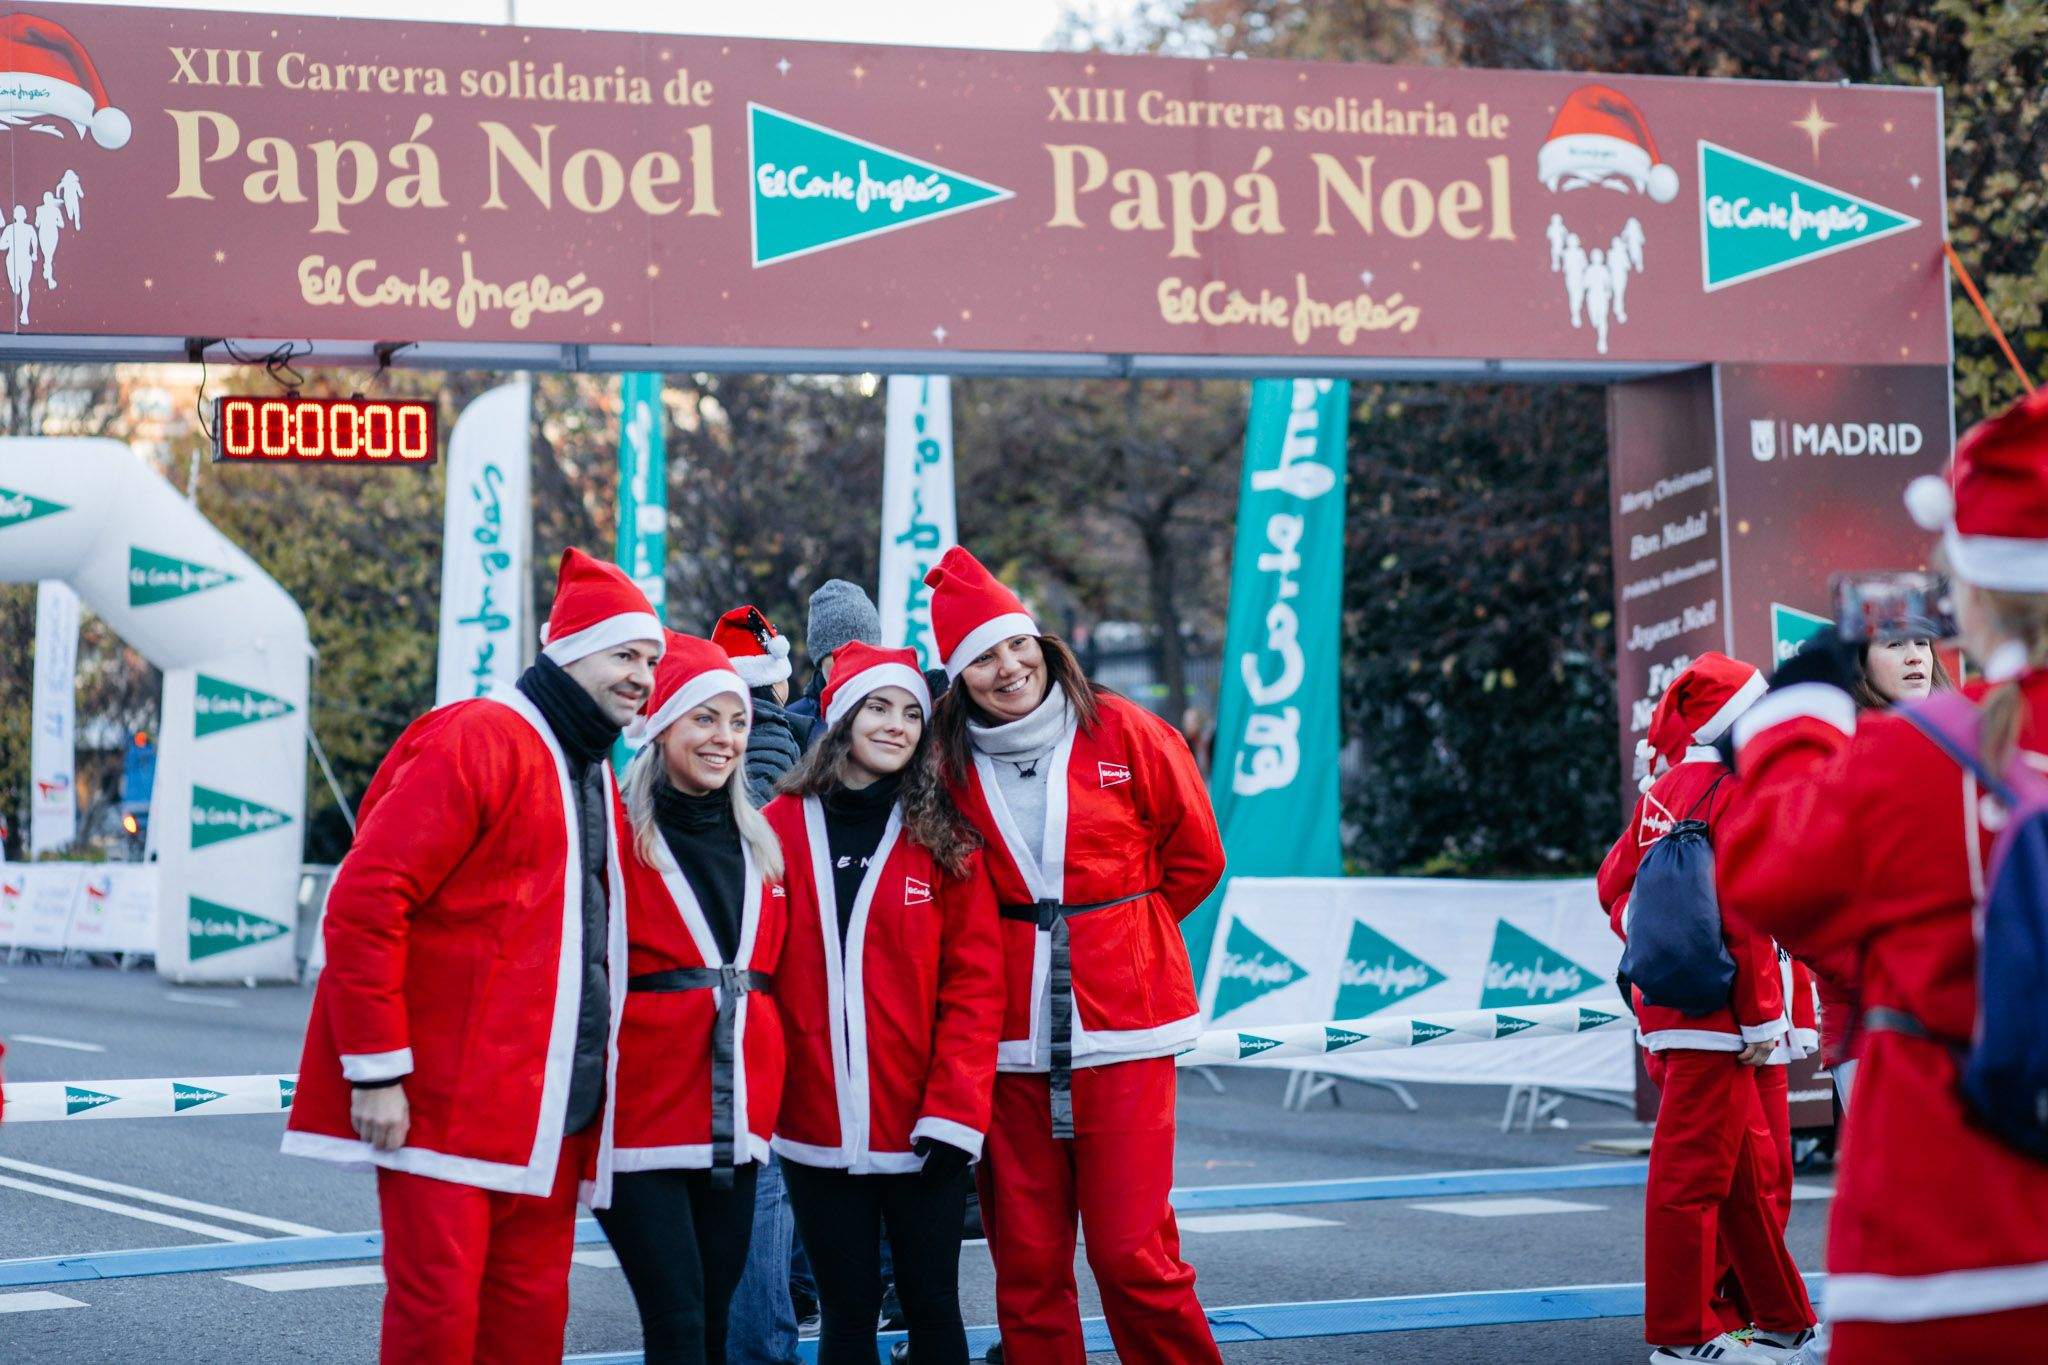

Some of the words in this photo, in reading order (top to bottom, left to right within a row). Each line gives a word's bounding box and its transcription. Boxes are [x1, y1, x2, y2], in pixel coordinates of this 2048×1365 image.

[168, 47, 263, 87] XIII
[276, 52, 448, 95] Carrera
[460, 60, 653, 104] solidaria
[664, 68, 714, 106] de
[1048, 86, 1127, 123] XIII
[1137, 90, 1285, 130] Carrera
[1294, 97, 1457, 137] solidaria
[1466, 102, 1510, 139] de
[164, 108, 450, 234] Papá
[478, 121, 723, 217] Noel
[757, 163, 788, 197] El
[787, 165, 855, 200] Corte
[855, 159, 950, 213] Inglés
[1044, 142, 1285, 258] Papá
[1311, 153, 1516, 241] Noel
[1708, 195, 1733, 229] El
[1733, 197, 1788, 230] Corte
[1788, 191, 1868, 241] Inglés
[298, 255, 344, 305] El
[347, 259, 451, 309] Corte
[456, 251, 604, 329] Inglés
[1158, 277, 1199, 324] El
[1200, 281, 1289, 328] Corte
[1292, 273, 1420, 345] Inglés
[226, 402, 427, 458] 00:00:00
[1792, 422, 1923, 456] MADRID
[456, 463, 511, 632] Inglés
[1241, 512, 1304, 705] Corte
[1232, 706, 1299, 796] El
